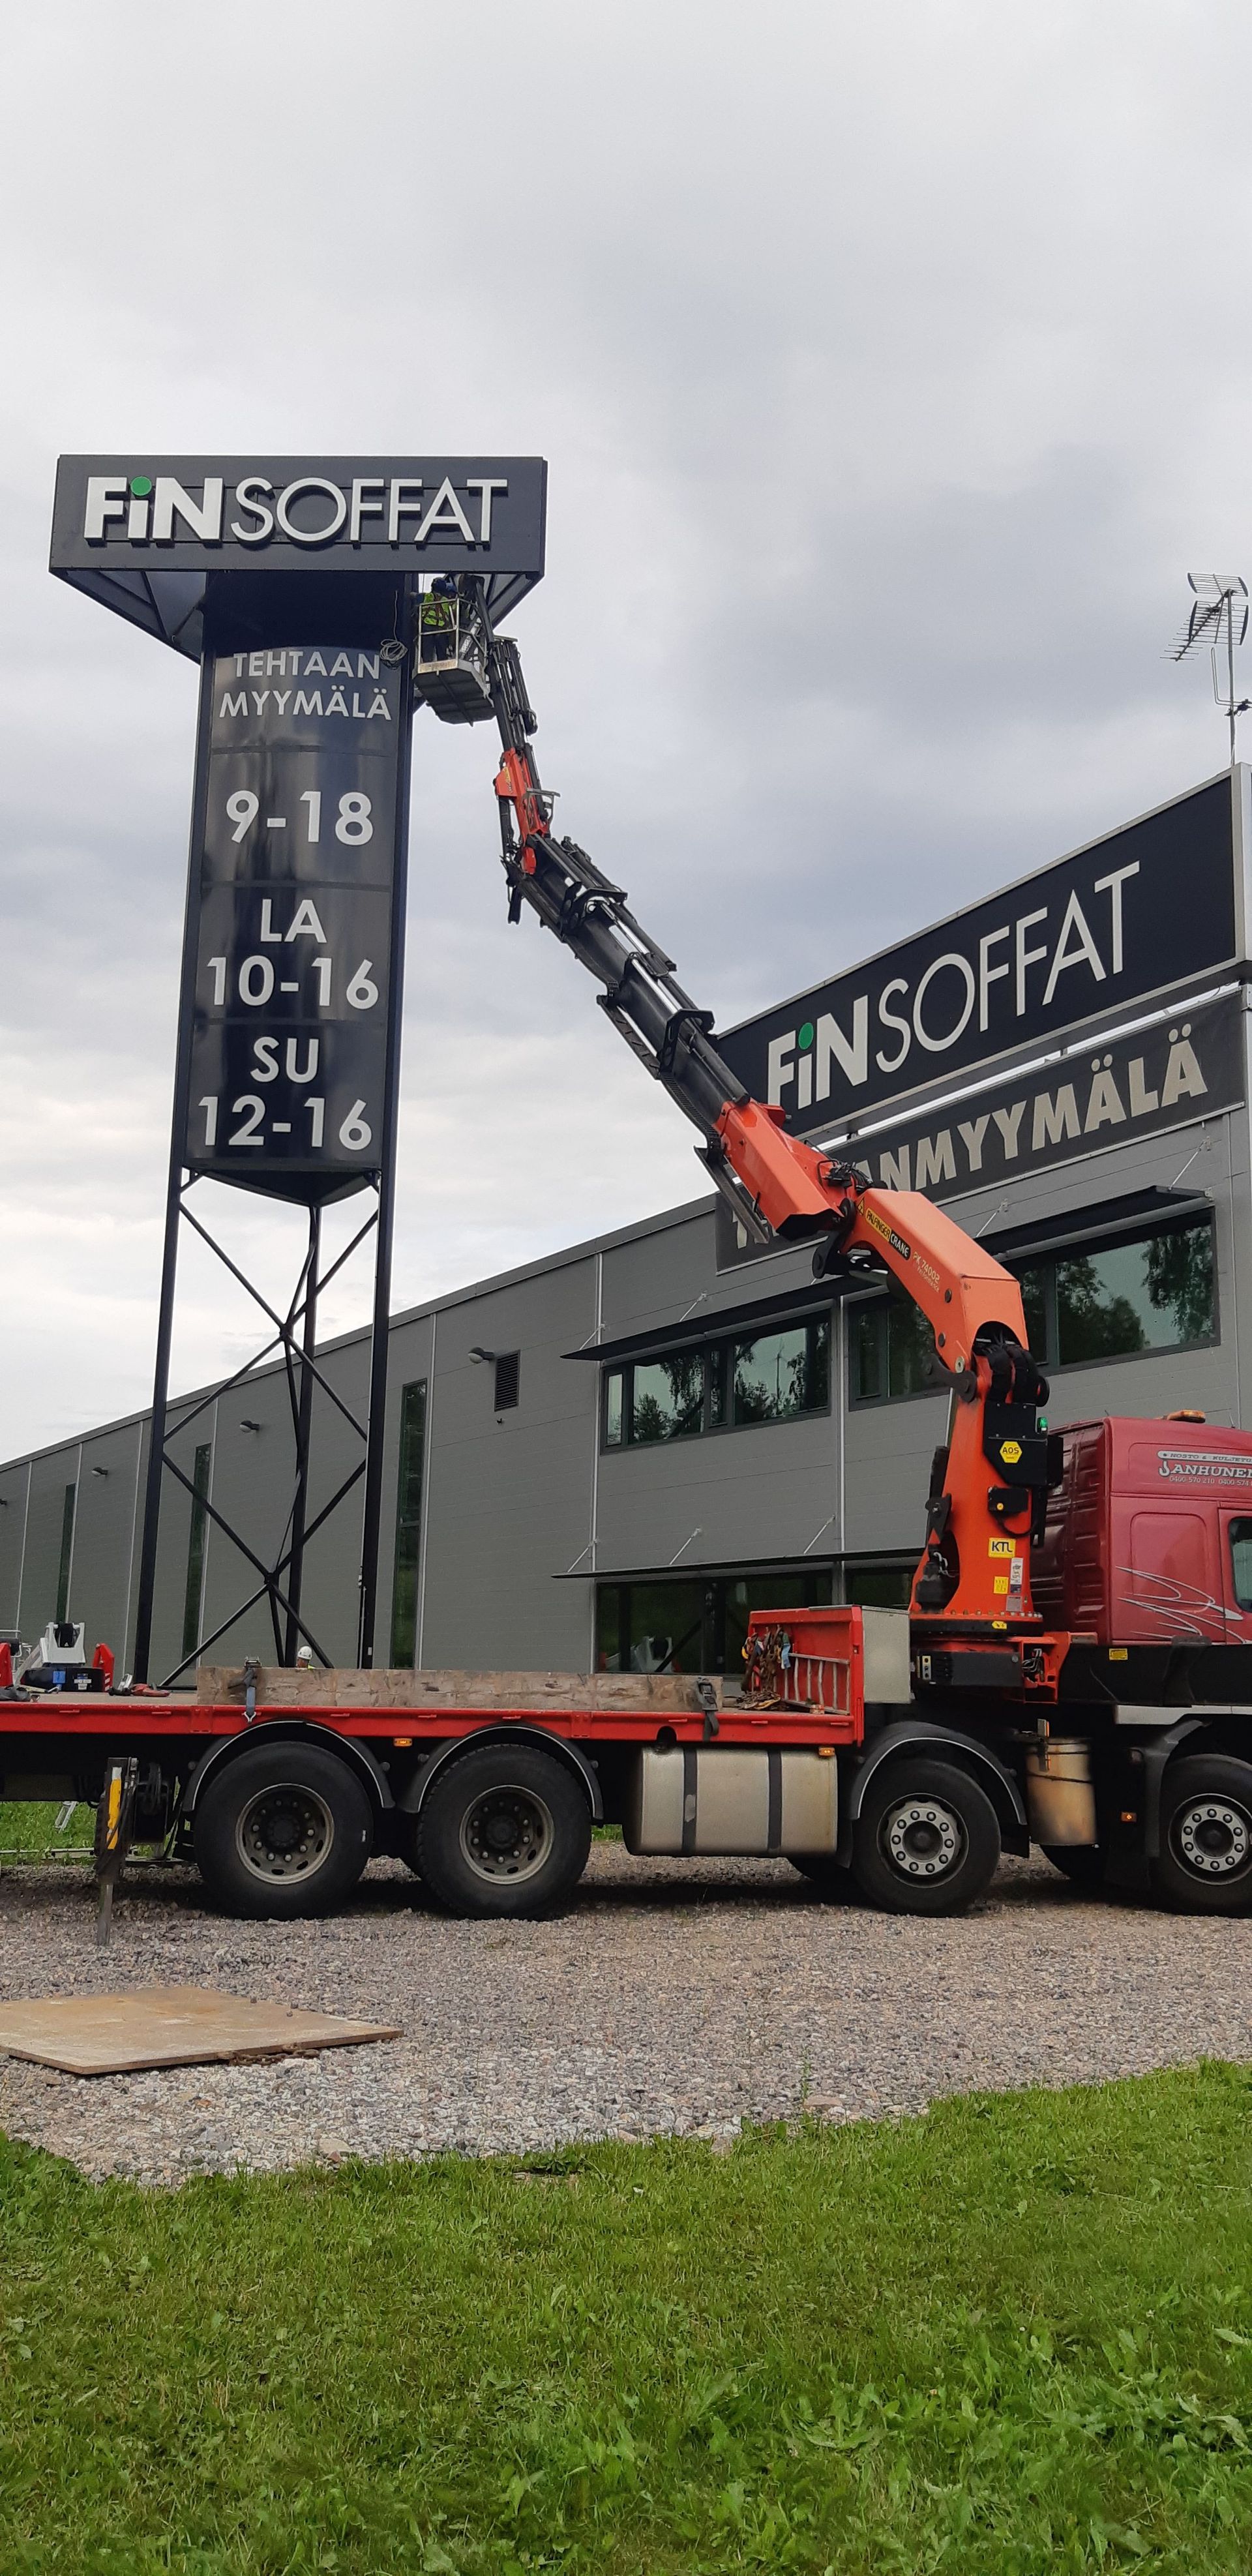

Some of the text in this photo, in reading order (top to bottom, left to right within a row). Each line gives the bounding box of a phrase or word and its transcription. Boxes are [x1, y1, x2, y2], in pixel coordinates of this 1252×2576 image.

[233, 651, 380, 679] TEHTAAN
[219, 685, 392, 720] MYYMÄLÄ
[226, 790, 373, 846] 9-18
[261, 899, 327, 943] LA
[207, 955, 378, 1010] 10-16
[250, 1036, 319, 1083] SU
[198, 1095, 372, 1150] 12-16
[867, 1210, 910, 1257] PALFINGER CRANE
[913, 1251, 921, 1265] PK
[921, 1260, 940, 1284] 74002
[992, 1541, 1013, 1553] KTL
